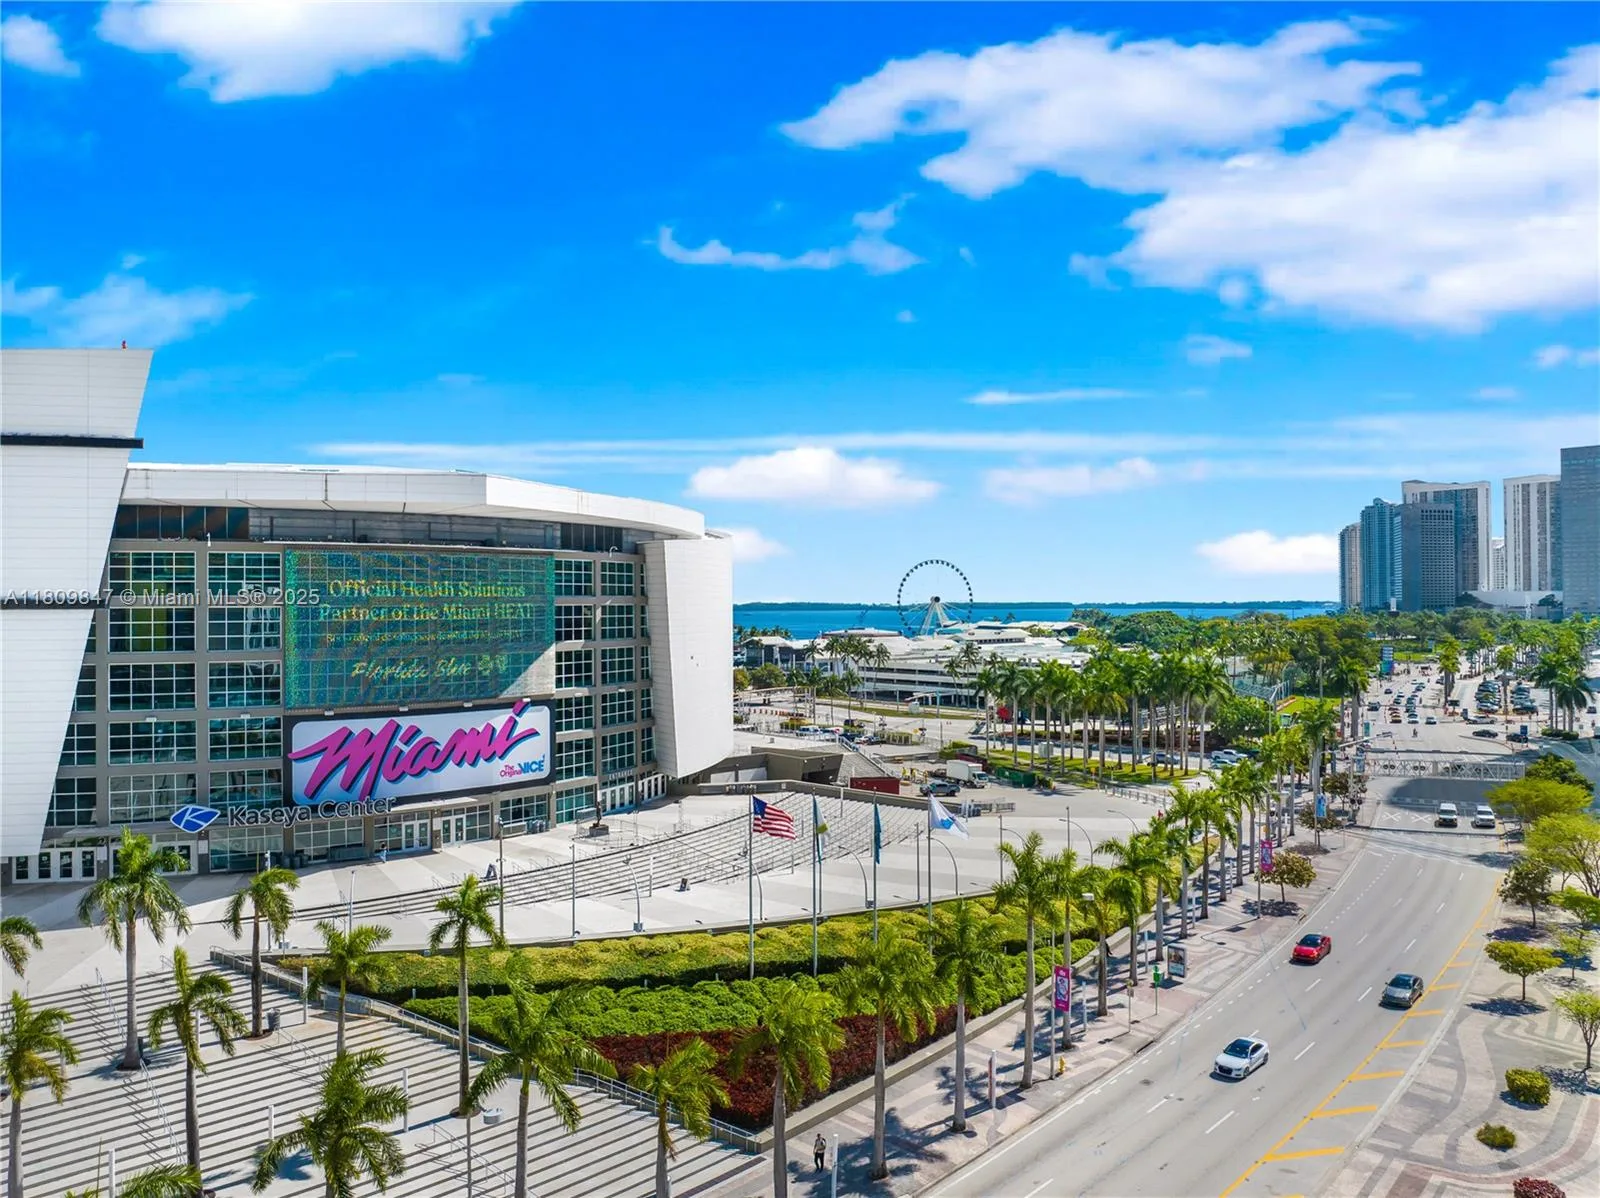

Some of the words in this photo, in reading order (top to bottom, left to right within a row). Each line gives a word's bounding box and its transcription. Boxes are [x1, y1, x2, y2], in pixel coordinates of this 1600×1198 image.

[329, 579, 396, 597] Official
[401, 580, 454, 597] Health
[458, 580, 525, 597] Solutions
[319, 603, 385, 621] Partner
[392, 602, 411, 620] of
[413, 603, 439, 620] the
[442, 602, 490, 619] Miami
[494, 602, 533, 619] HEAT
[288, 698, 540, 801] Miami
[518, 760, 545, 773] VICE
[228, 804, 311, 828] Kaseya
[318, 796, 397, 819] Center
